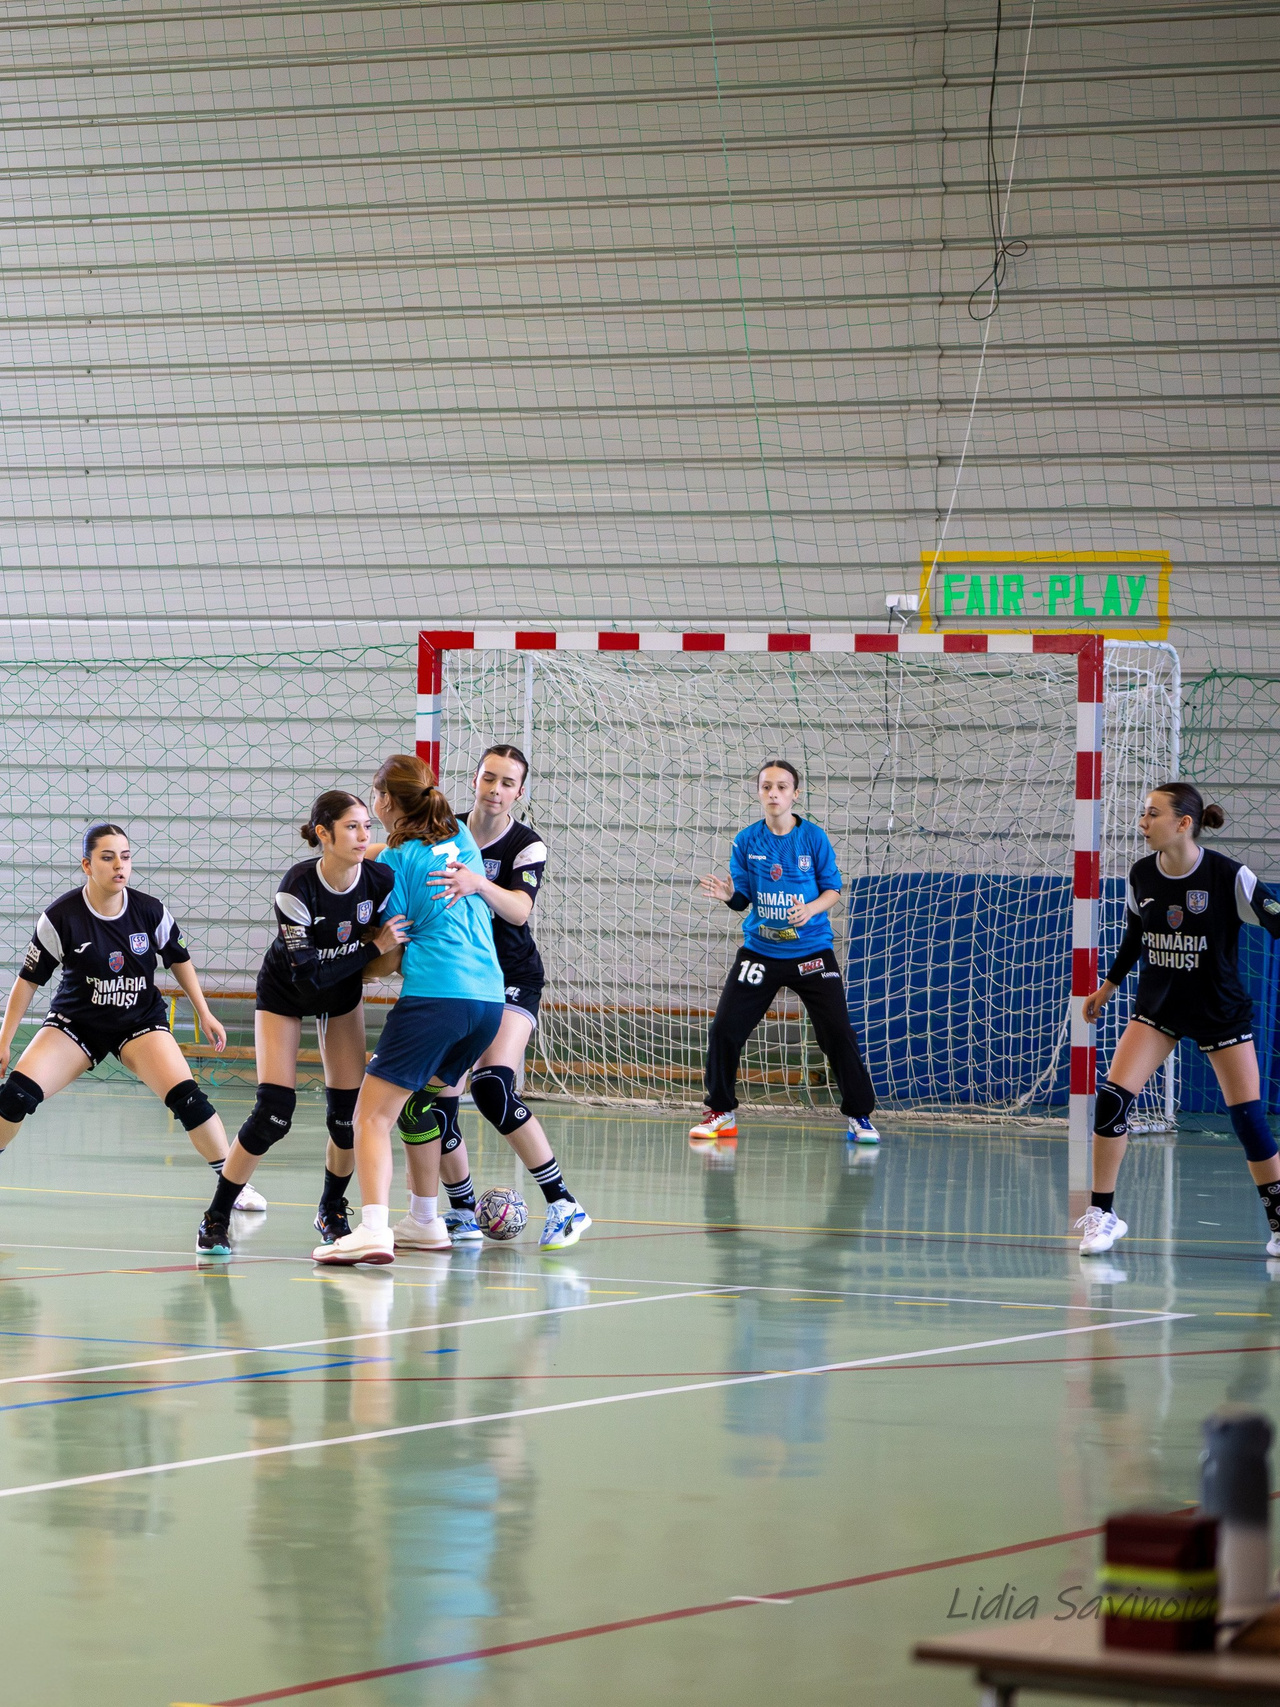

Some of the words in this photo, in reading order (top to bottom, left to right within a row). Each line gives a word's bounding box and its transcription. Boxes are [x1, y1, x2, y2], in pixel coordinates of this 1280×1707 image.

[943, 573, 1146, 616] FAIR-PLAY
[757, 890, 806, 907] RIMĂRIA
[1141, 931, 1208, 952] PRIMĂRIA
[1148, 949, 1200, 972] BUHUȘI
[737, 960, 766, 986] 16
[86, 975, 147, 993] PRIMĂRIA
[91, 991, 138, 1009] BUHUȘI
[270, 1115, 288, 1126] SELECT
